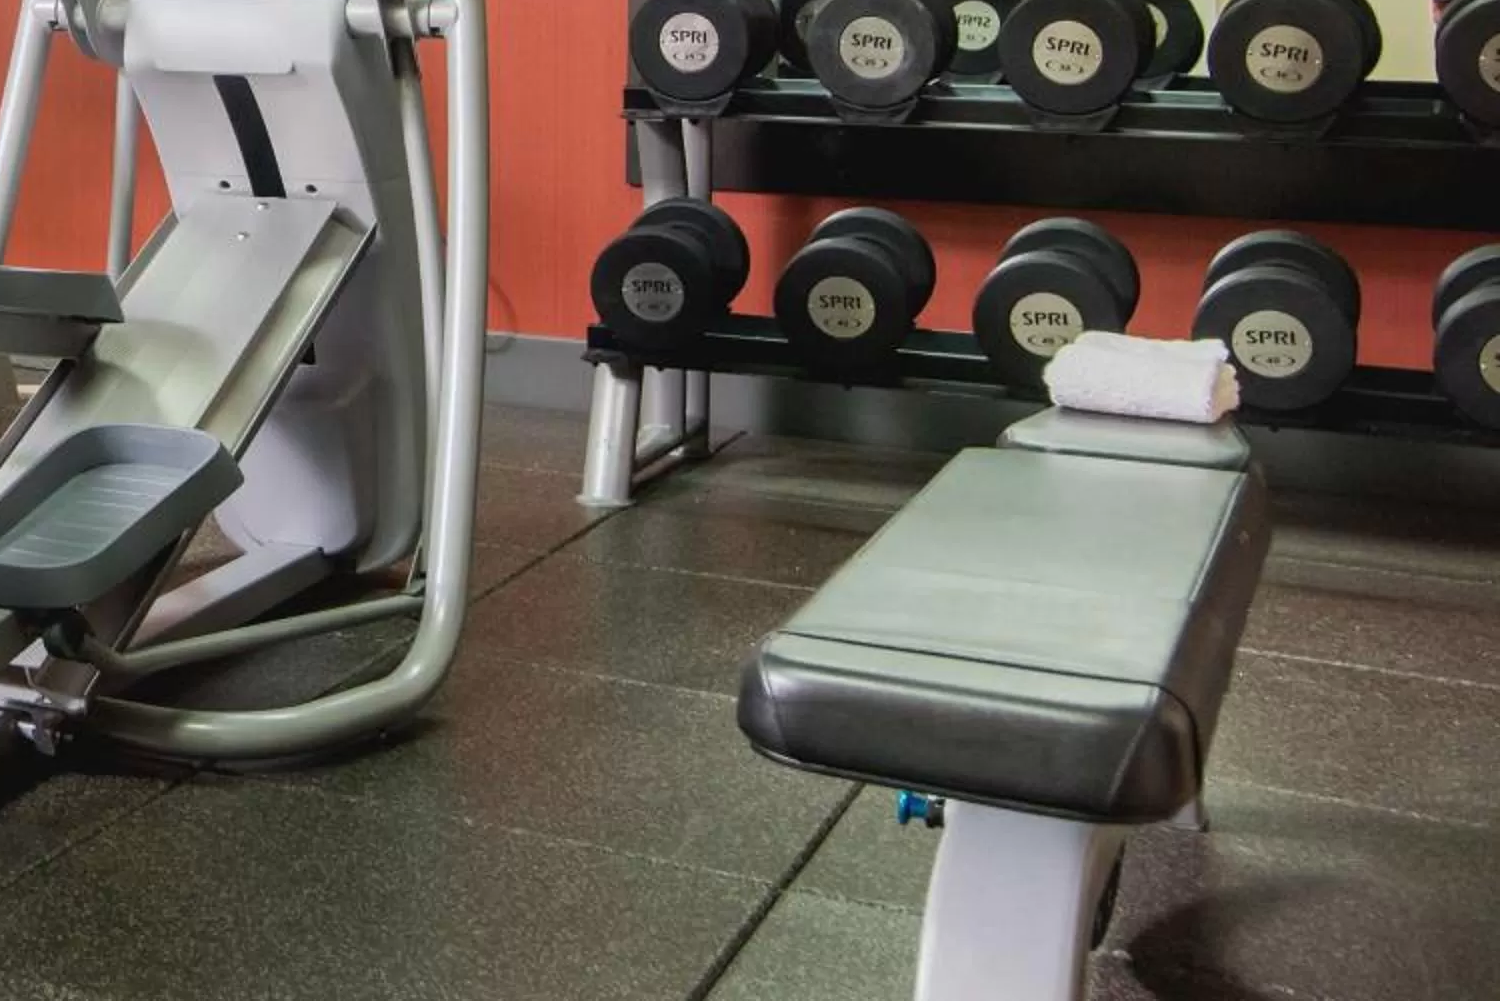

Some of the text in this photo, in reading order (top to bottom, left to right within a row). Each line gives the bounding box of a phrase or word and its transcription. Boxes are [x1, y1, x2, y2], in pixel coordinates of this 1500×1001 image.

[670, 29, 708, 44] SPRI
[851, 33, 892, 50] SPRI
[1045, 36, 1091, 57] SPRI
[1260, 42, 1309, 64] SPRI
[819, 294, 862, 310] SPRI
[1021, 310, 1070, 327] SPRI
[1245, 330, 1297, 346] SPRI
